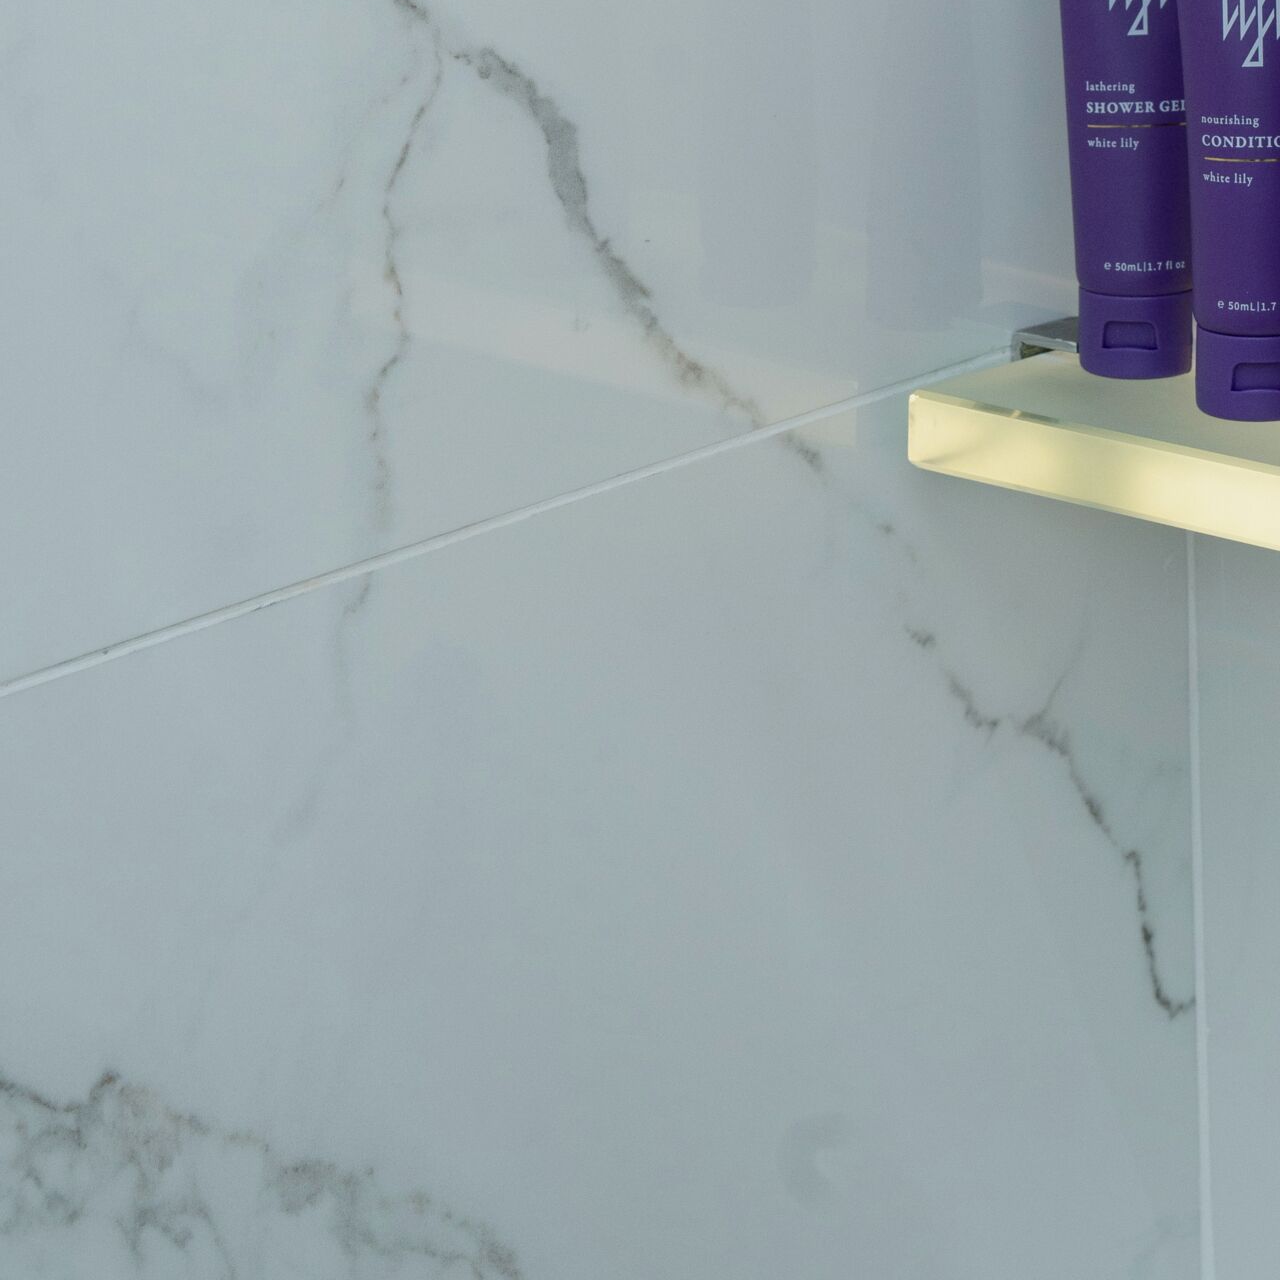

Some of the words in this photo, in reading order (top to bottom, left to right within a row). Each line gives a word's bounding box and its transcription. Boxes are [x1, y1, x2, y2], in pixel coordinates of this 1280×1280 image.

[1085, 80, 1136, 95] lathering
[1086, 101, 1156, 115] SHOWER
[1201, 114, 1260, 129] nourishing
[1087, 137, 1117, 148] white
[1120, 137, 1140, 151] lily
[1202, 171, 1231, 184] white
[1234, 172, 1253, 188] lily
[1165, 260, 1174, 271] fl
[1175, 261, 1186, 270] oz
